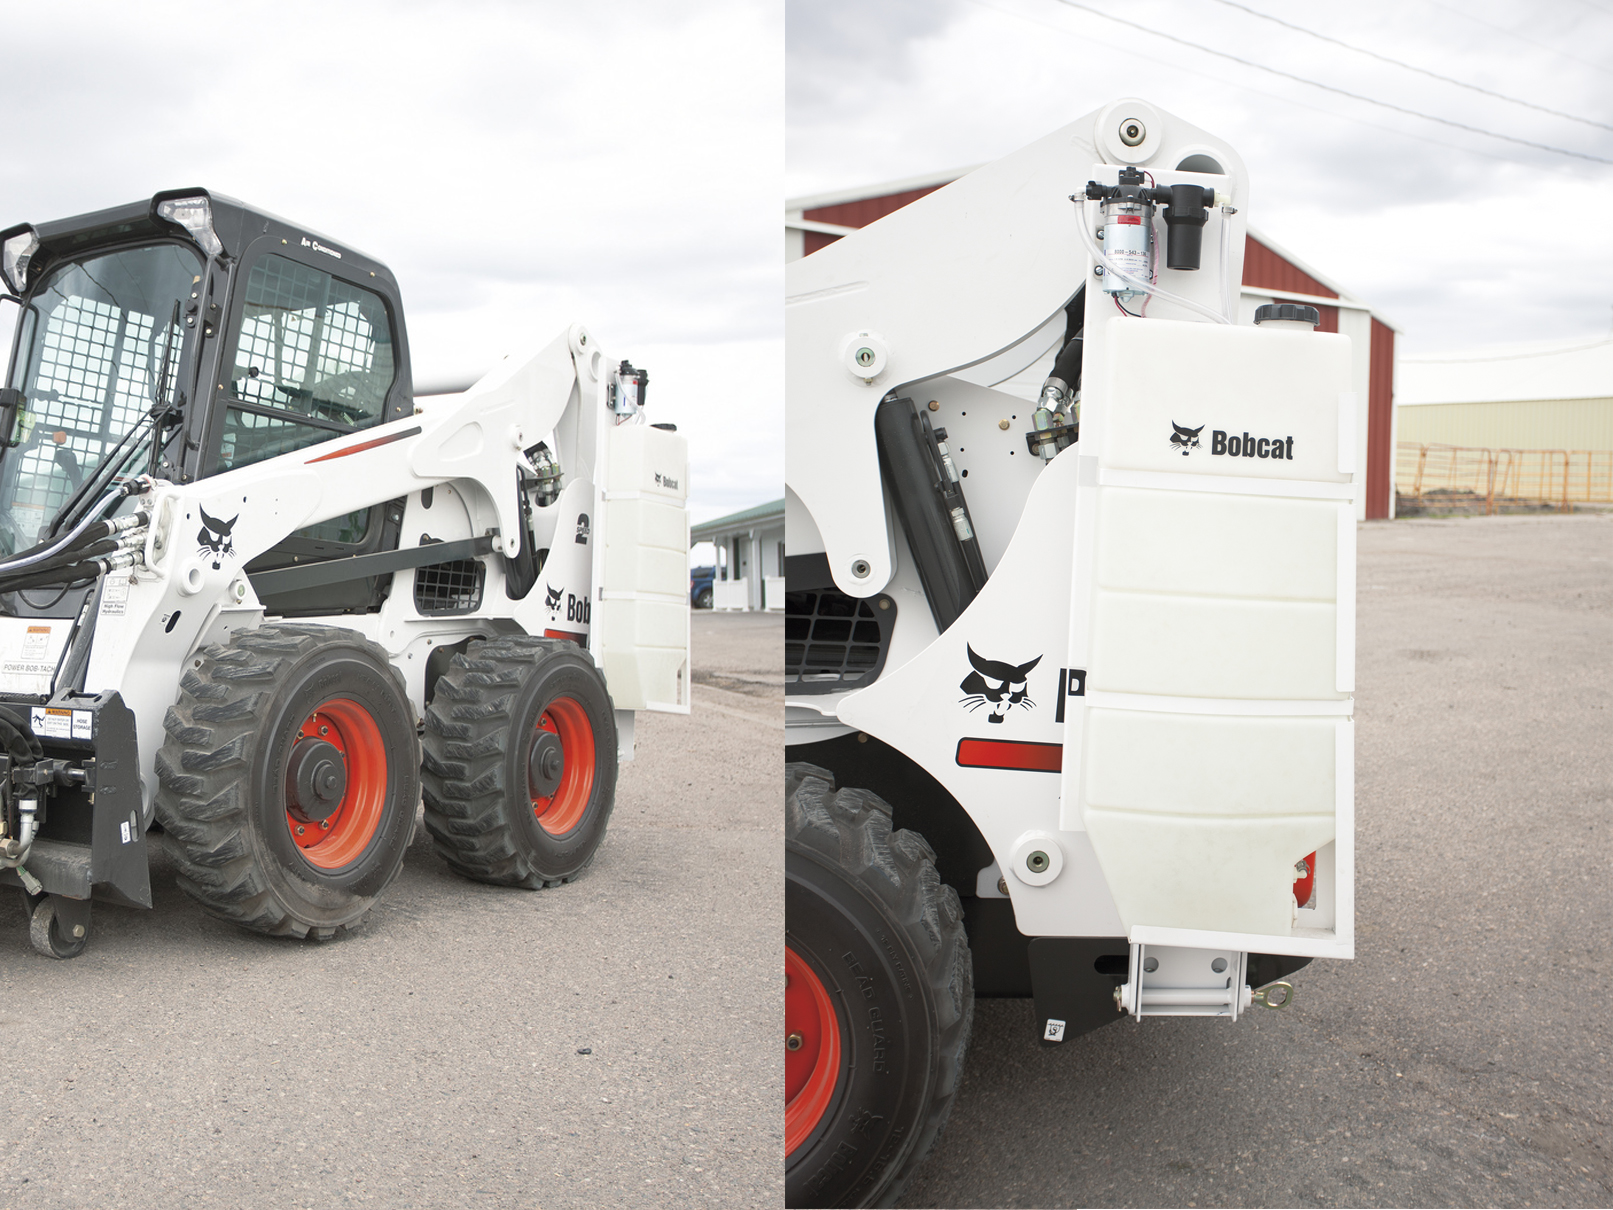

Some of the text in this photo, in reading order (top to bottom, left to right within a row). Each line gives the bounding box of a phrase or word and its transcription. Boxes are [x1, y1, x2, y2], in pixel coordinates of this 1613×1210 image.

[1211, 429, 1294, 460] Bobcat
[663, 476, 678, 490] Bobcat
[575, 512, 590, 545] 2
[4, 663, 25, 671] POWER
[841, 951, 885, 1073] BEAD GUARD
